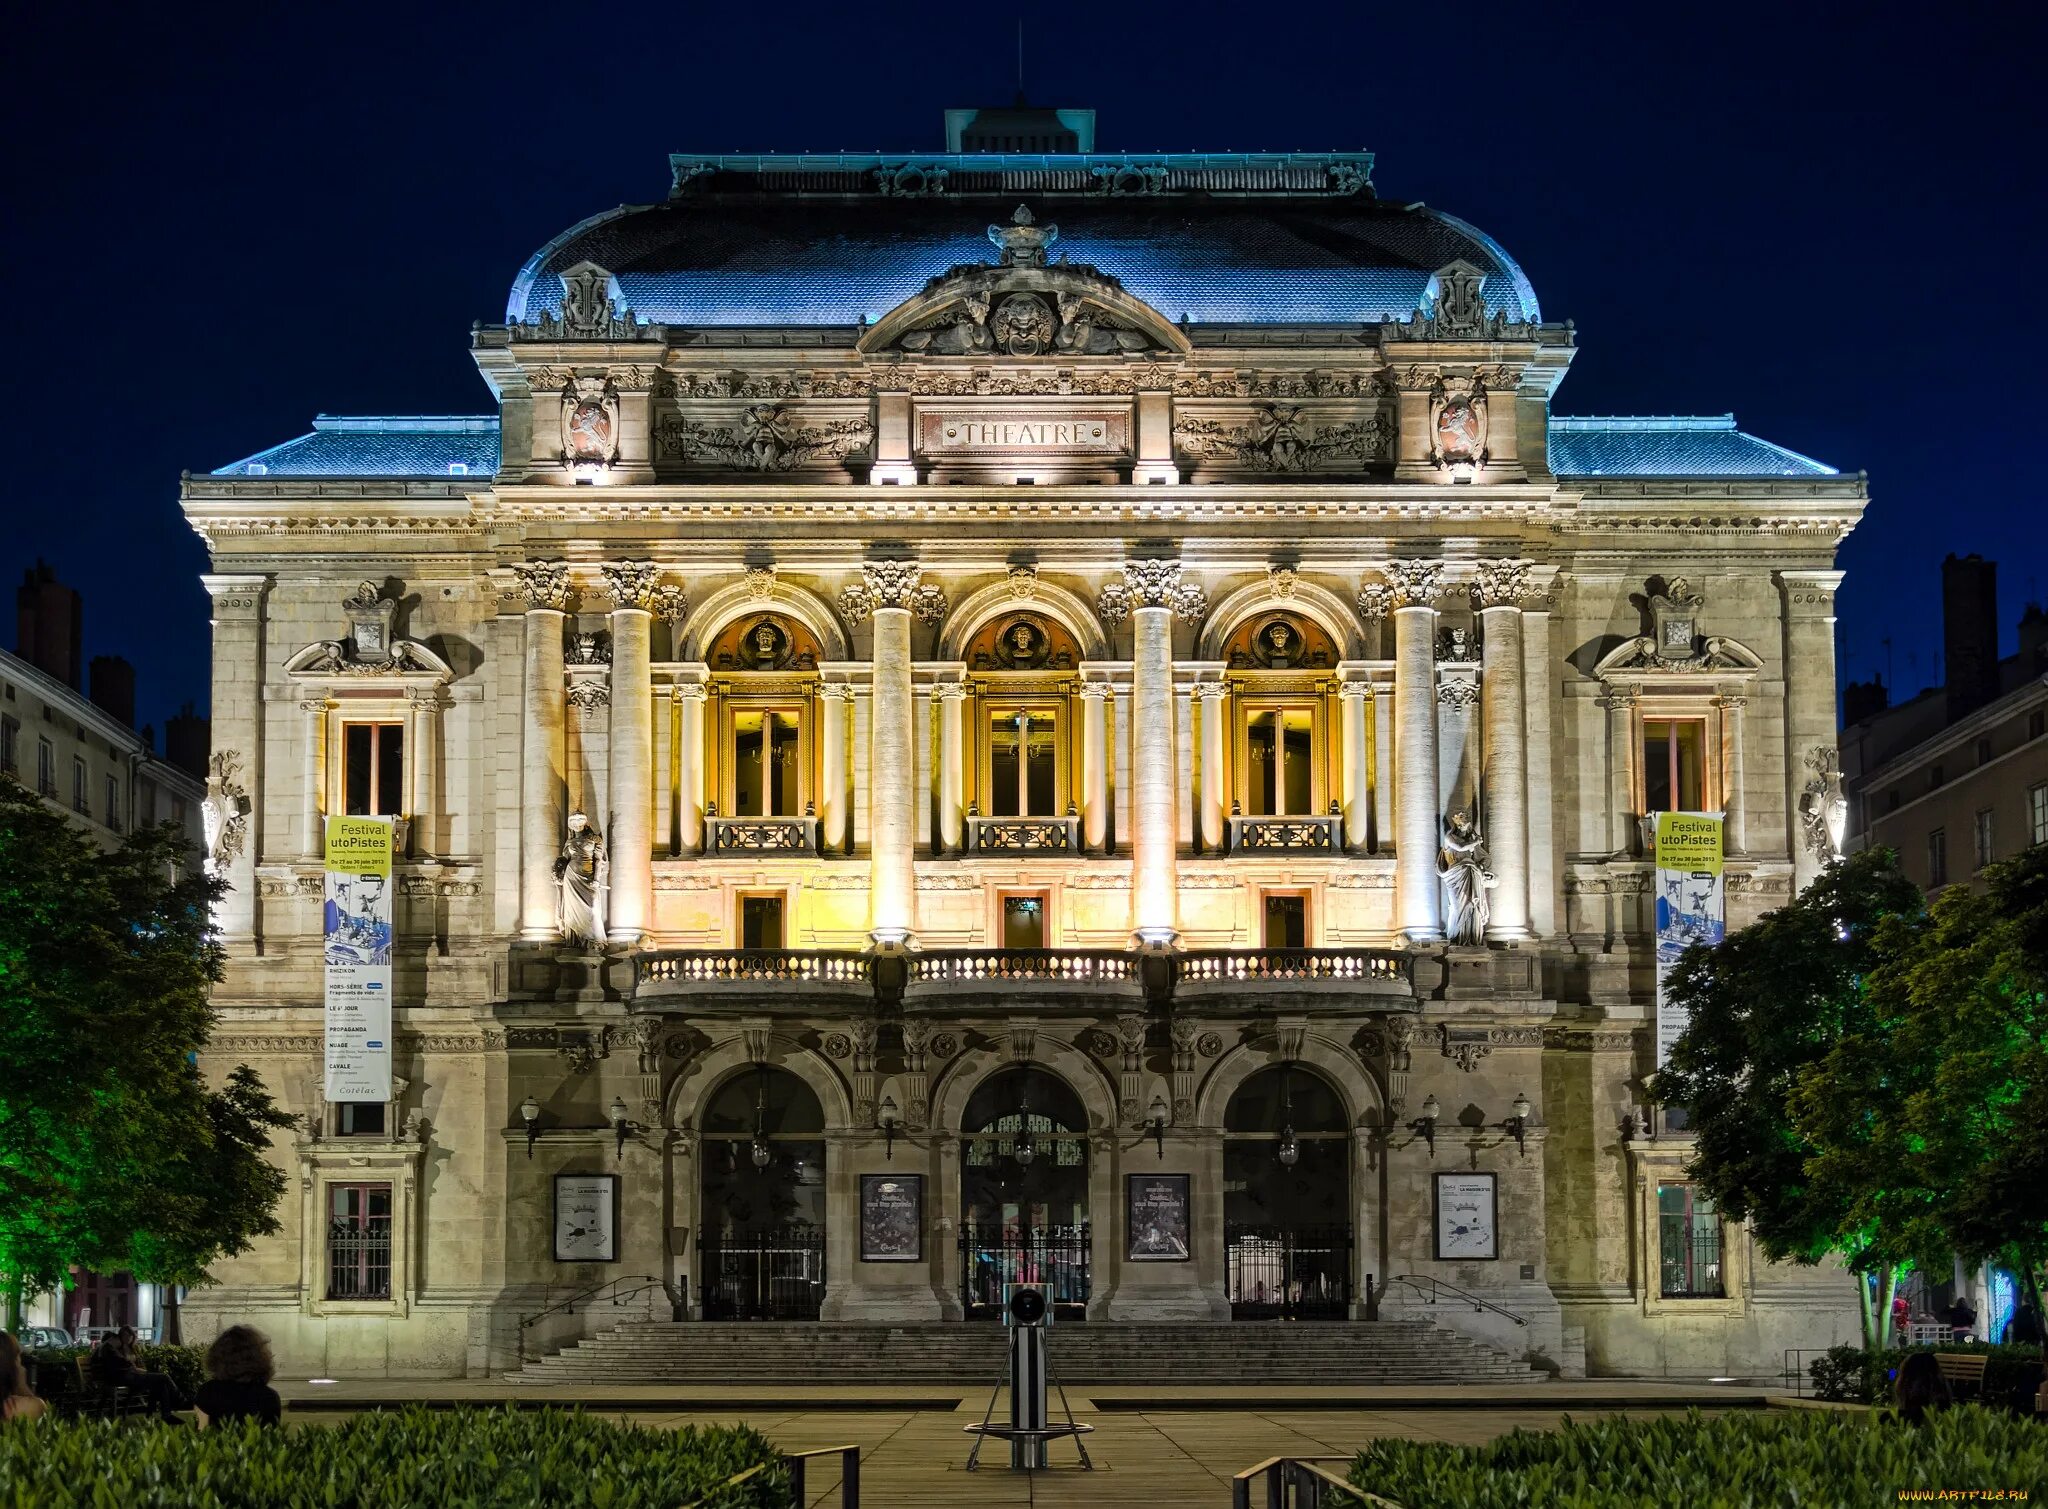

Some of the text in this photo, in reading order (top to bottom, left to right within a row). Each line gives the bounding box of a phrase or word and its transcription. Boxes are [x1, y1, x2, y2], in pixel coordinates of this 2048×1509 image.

[961, 422, 1088, 444] THEATRE
[341, 824, 386, 835] Festival
[1671, 821, 1717, 833] Festival
[331, 837, 386, 848] utoPistes
[1661, 834, 1717, 846] utoPistes
